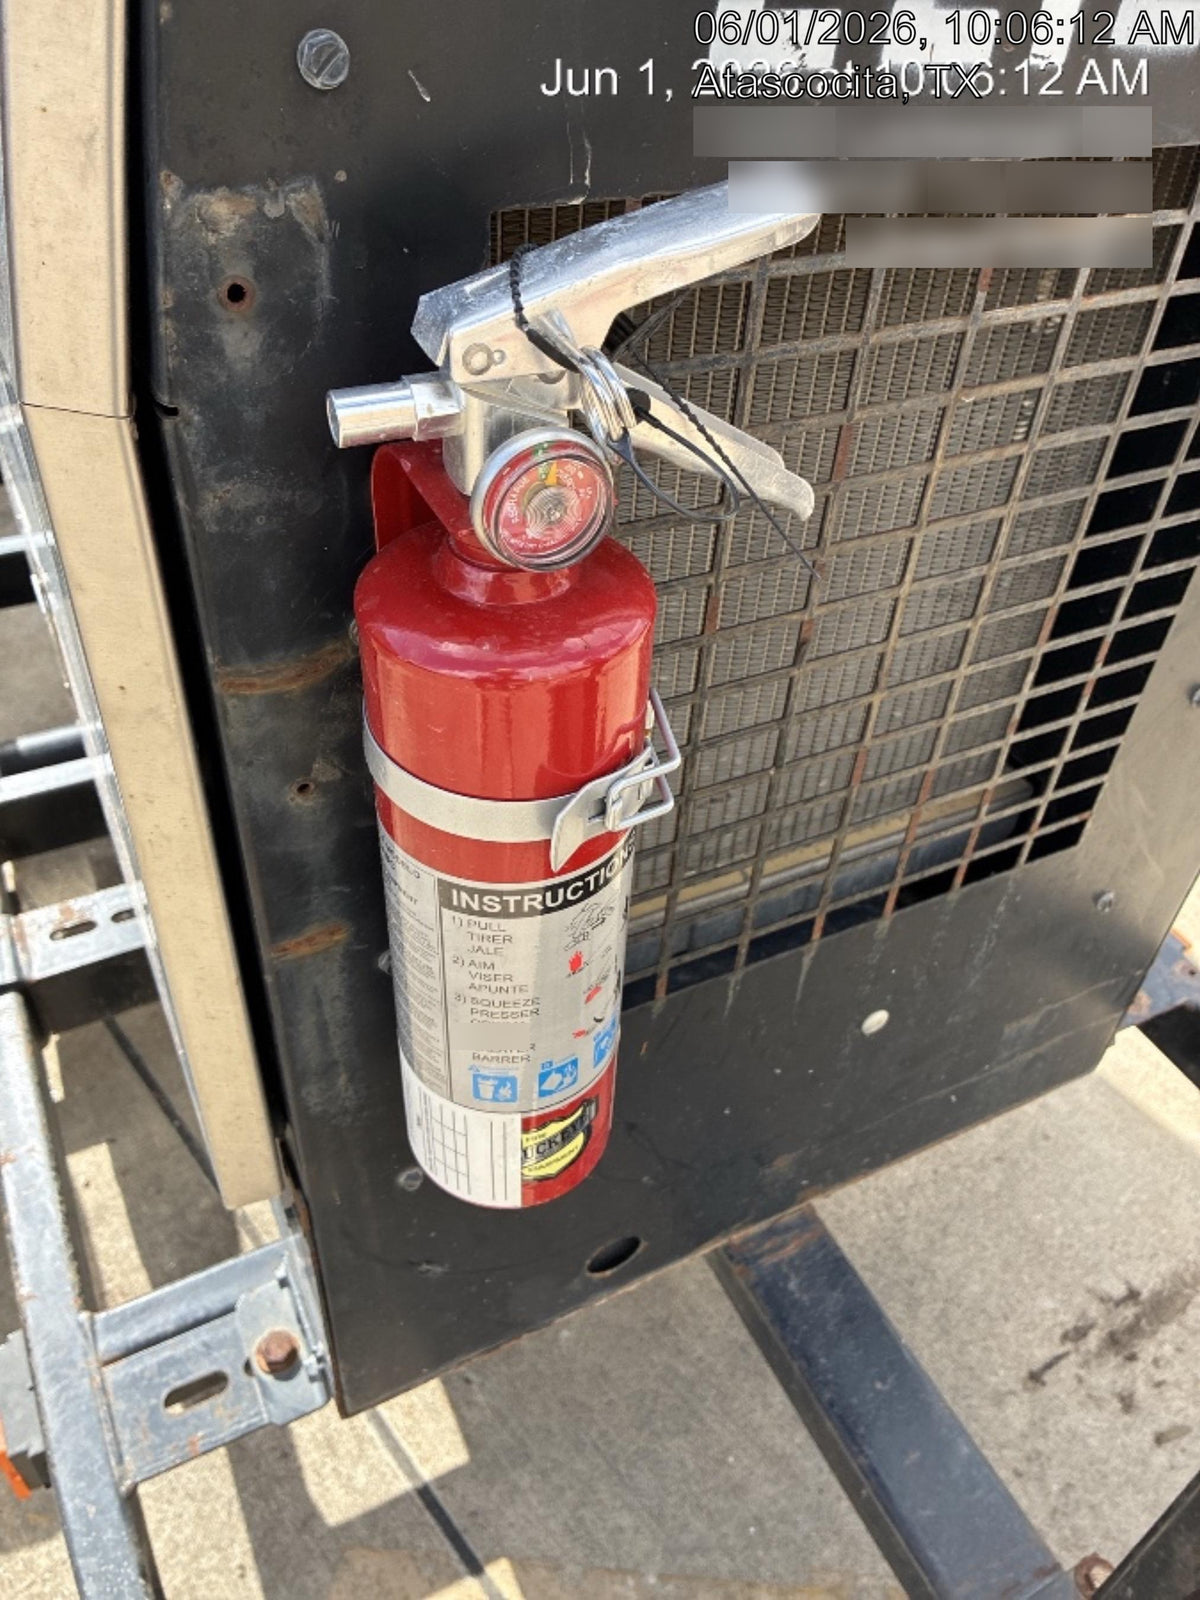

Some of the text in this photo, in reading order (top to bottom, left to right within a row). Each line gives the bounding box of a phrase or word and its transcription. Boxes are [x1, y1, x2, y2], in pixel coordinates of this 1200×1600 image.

[451, 917, 507, 933] 1) PULL
[466, 931, 514, 945] TIRER
[467, 946, 504, 957] JALE
[452, 955, 496, 971] 2) AIM
[468, 972, 514, 983] VISER
[467, 983, 530, 995] APUNTE
[469, 996, 541, 1010] SQUEEZE
[470, 1007, 541, 1018] PRESSER
[472, 1051, 532, 1065] BARRER
[521, 1098, 597, 1164] UCKEYE
